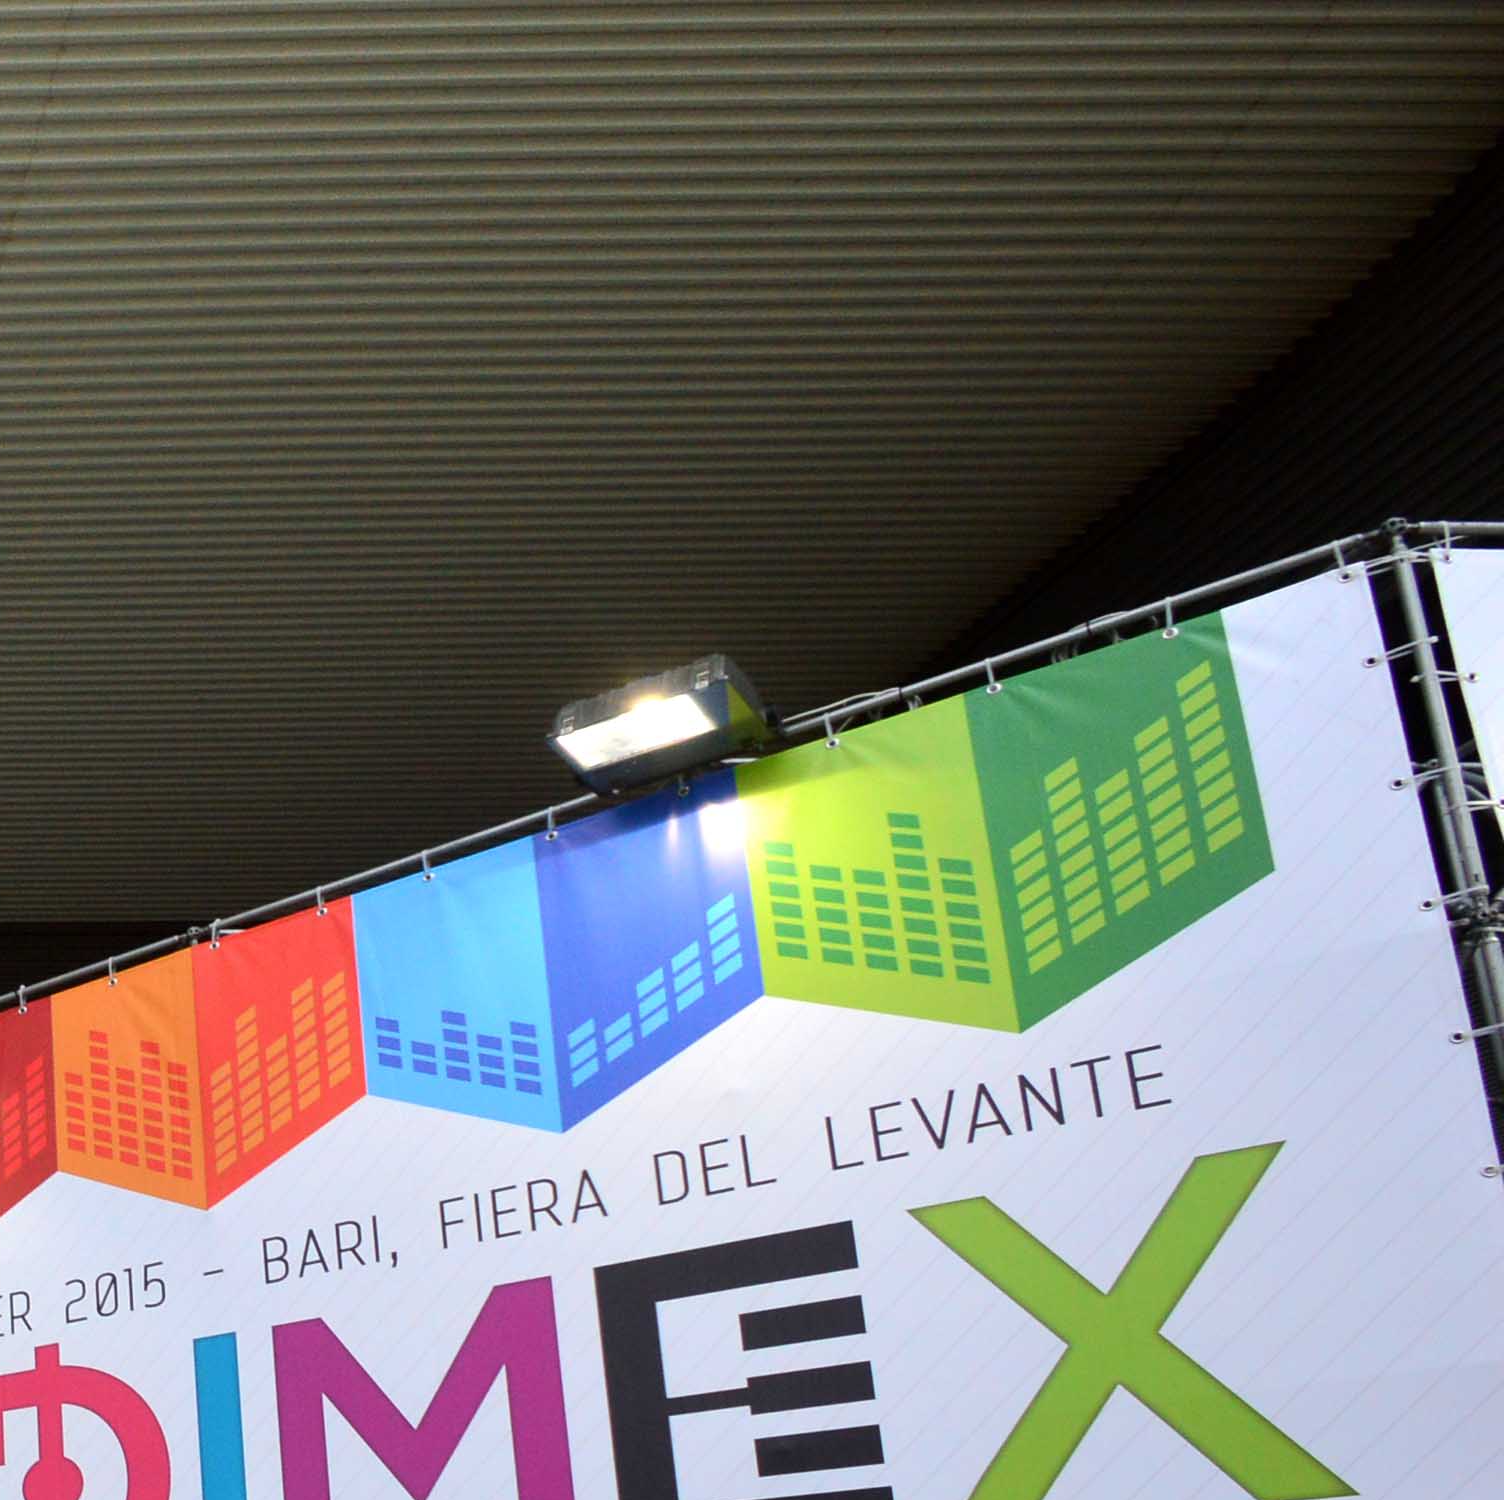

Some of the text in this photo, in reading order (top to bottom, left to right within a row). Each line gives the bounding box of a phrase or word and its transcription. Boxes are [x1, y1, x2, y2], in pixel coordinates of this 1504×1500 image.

[63, 1260, 168, 1325] 2015
[261, 1215, 400, 1288] BARI,
[437, 1169, 610, 1251] FIERA
[650, 1133, 778, 1207] DEL
[822, 1044, 1173, 1174] LEVANTE
